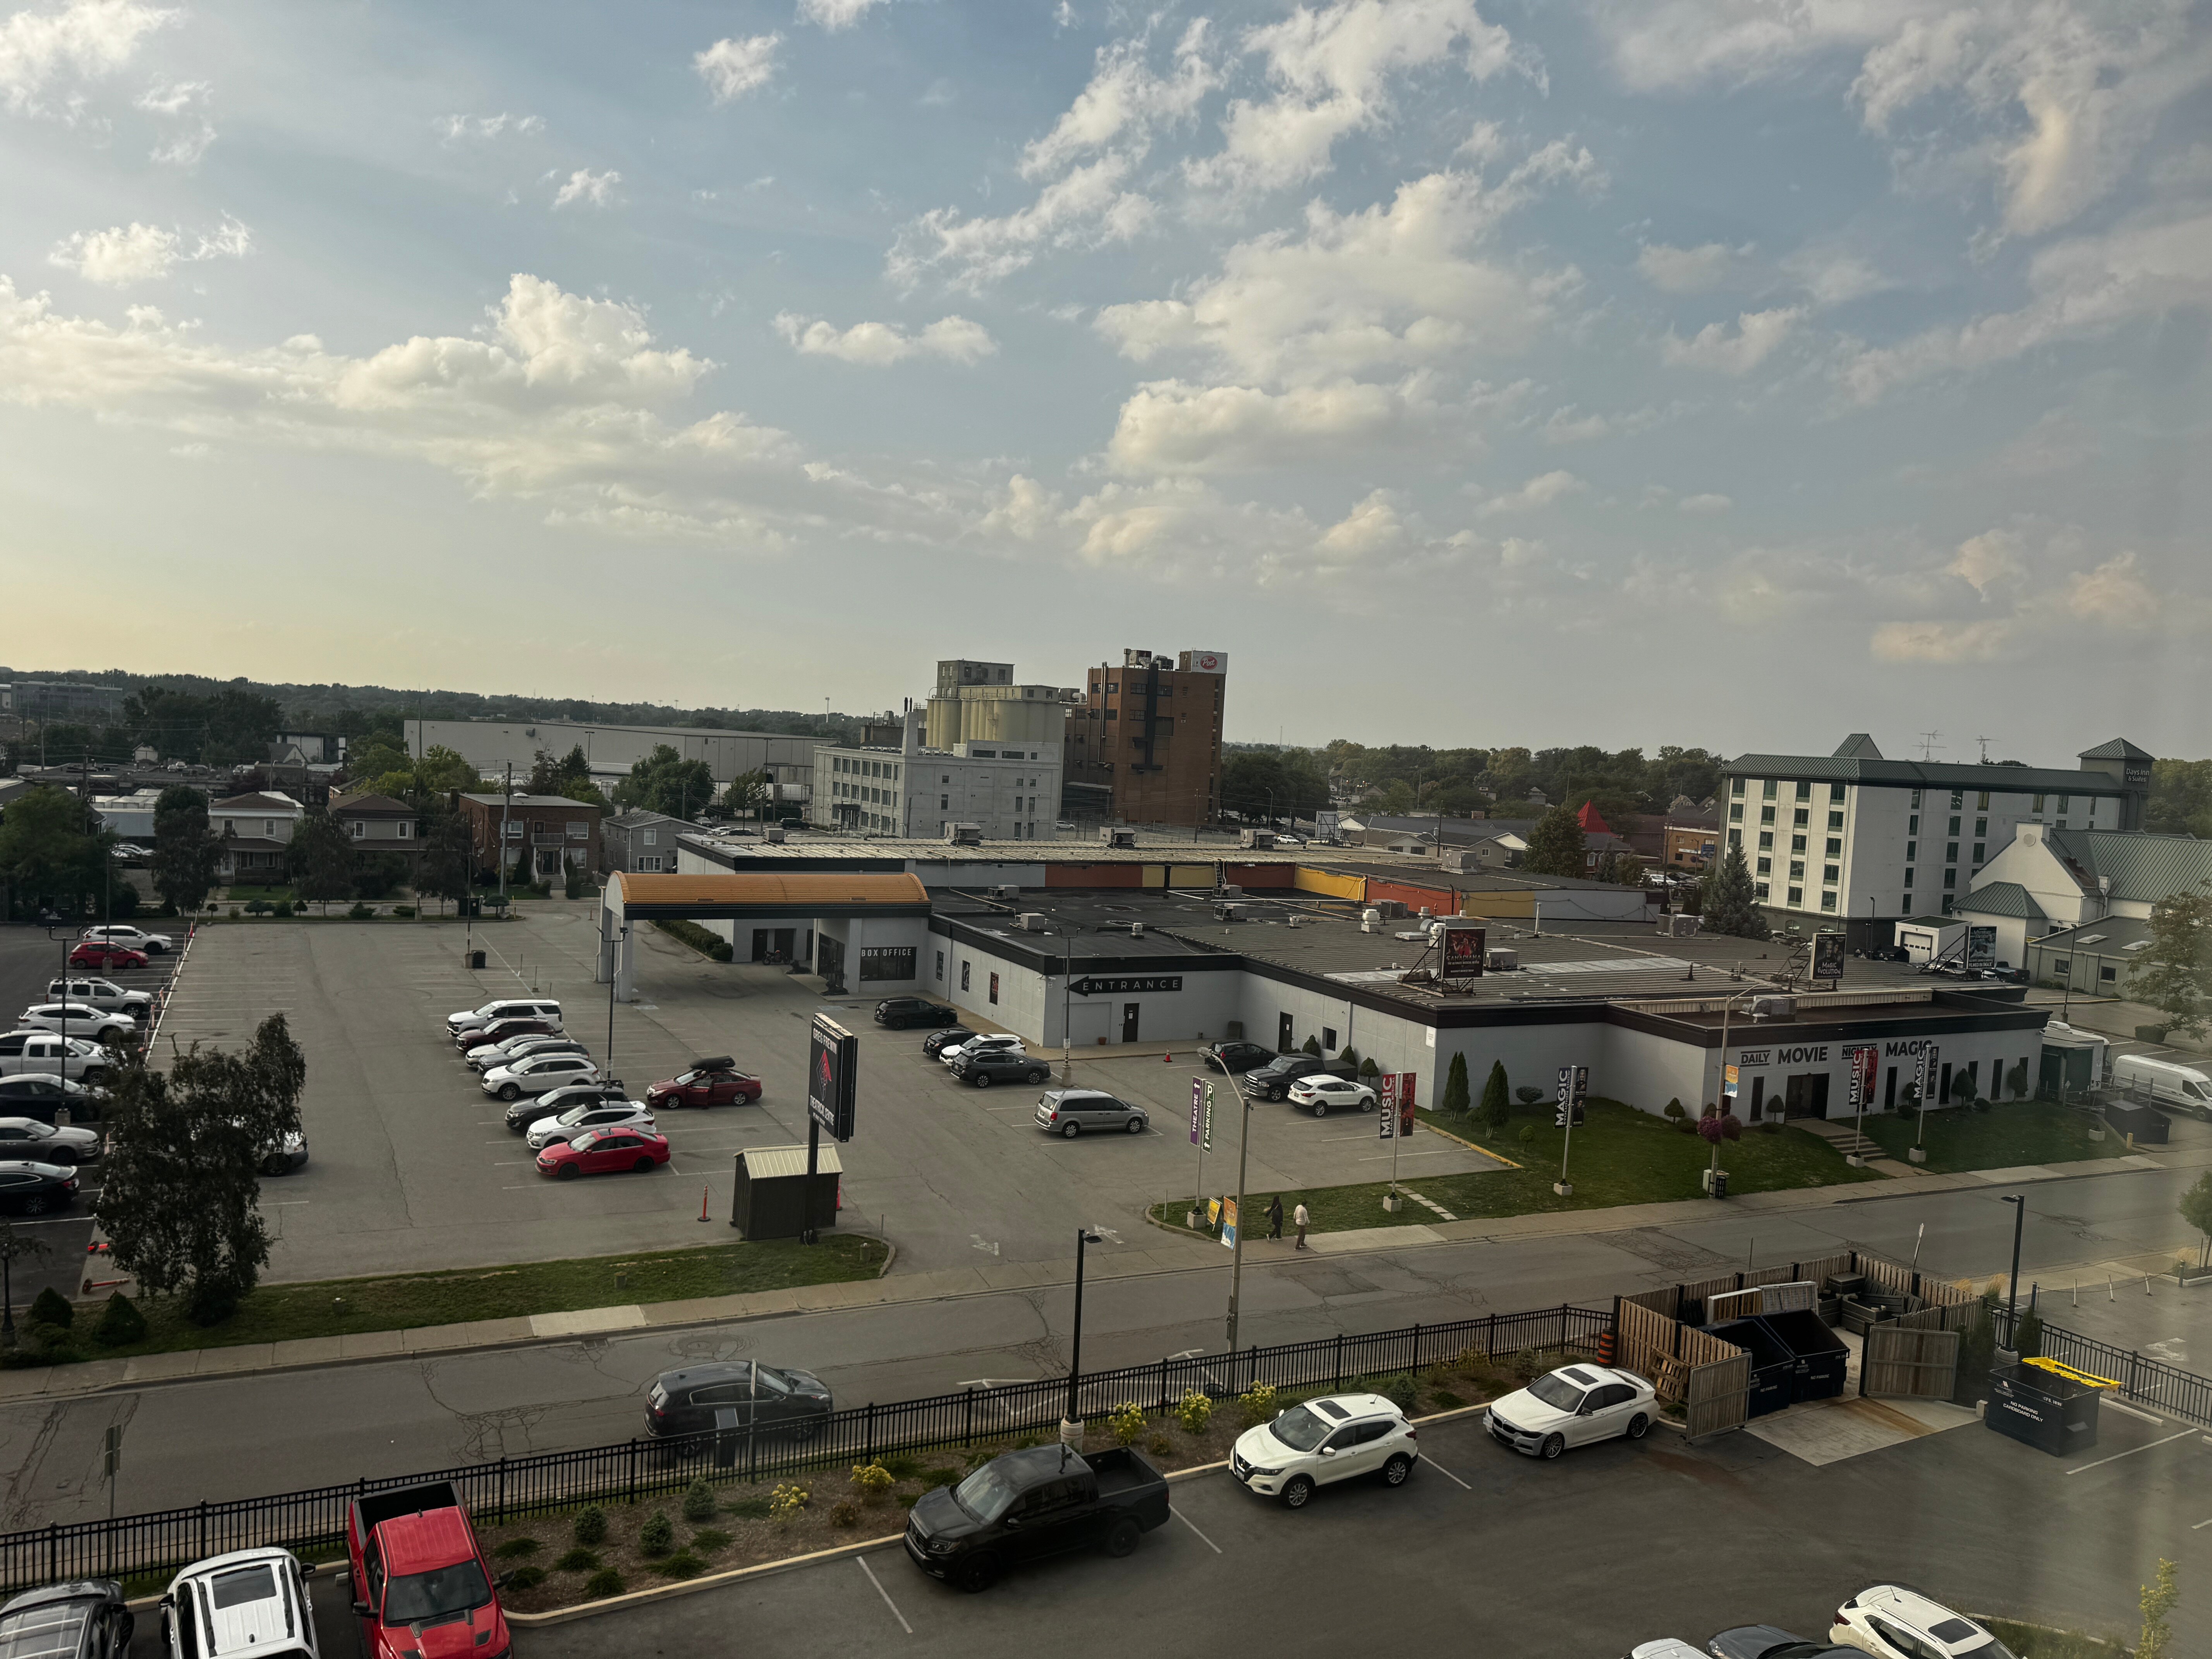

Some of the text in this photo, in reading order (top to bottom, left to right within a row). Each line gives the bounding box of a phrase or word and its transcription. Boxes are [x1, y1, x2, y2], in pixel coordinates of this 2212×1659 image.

[1201, 658, 1215, 666] Post
[1083, 980, 1178, 991] ENTRANCE
[813, 1028, 837, 1054] GREG FREWIN
[1741, 1053, 1770, 1064] DAILY
[1778, 1046, 1828, 1064] MOVIE
[1850, 1053, 1861, 1103] MUSIC
[1913, 1050, 1924, 1098] MAGIC
[1207, 1085, 1212, 1097] P
[1555, 1070, 1568, 1126] MAGIC
[810, 1095, 825, 1117] THEATRICAL
[824, 1108, 834, 1125] CENTRE
[1381, 1077, 1392, 1136] MUSIC
[2003, 1403, 2030, 1417] CARDBOARD
[2018, 1404, 2038, 1415] PARKING
